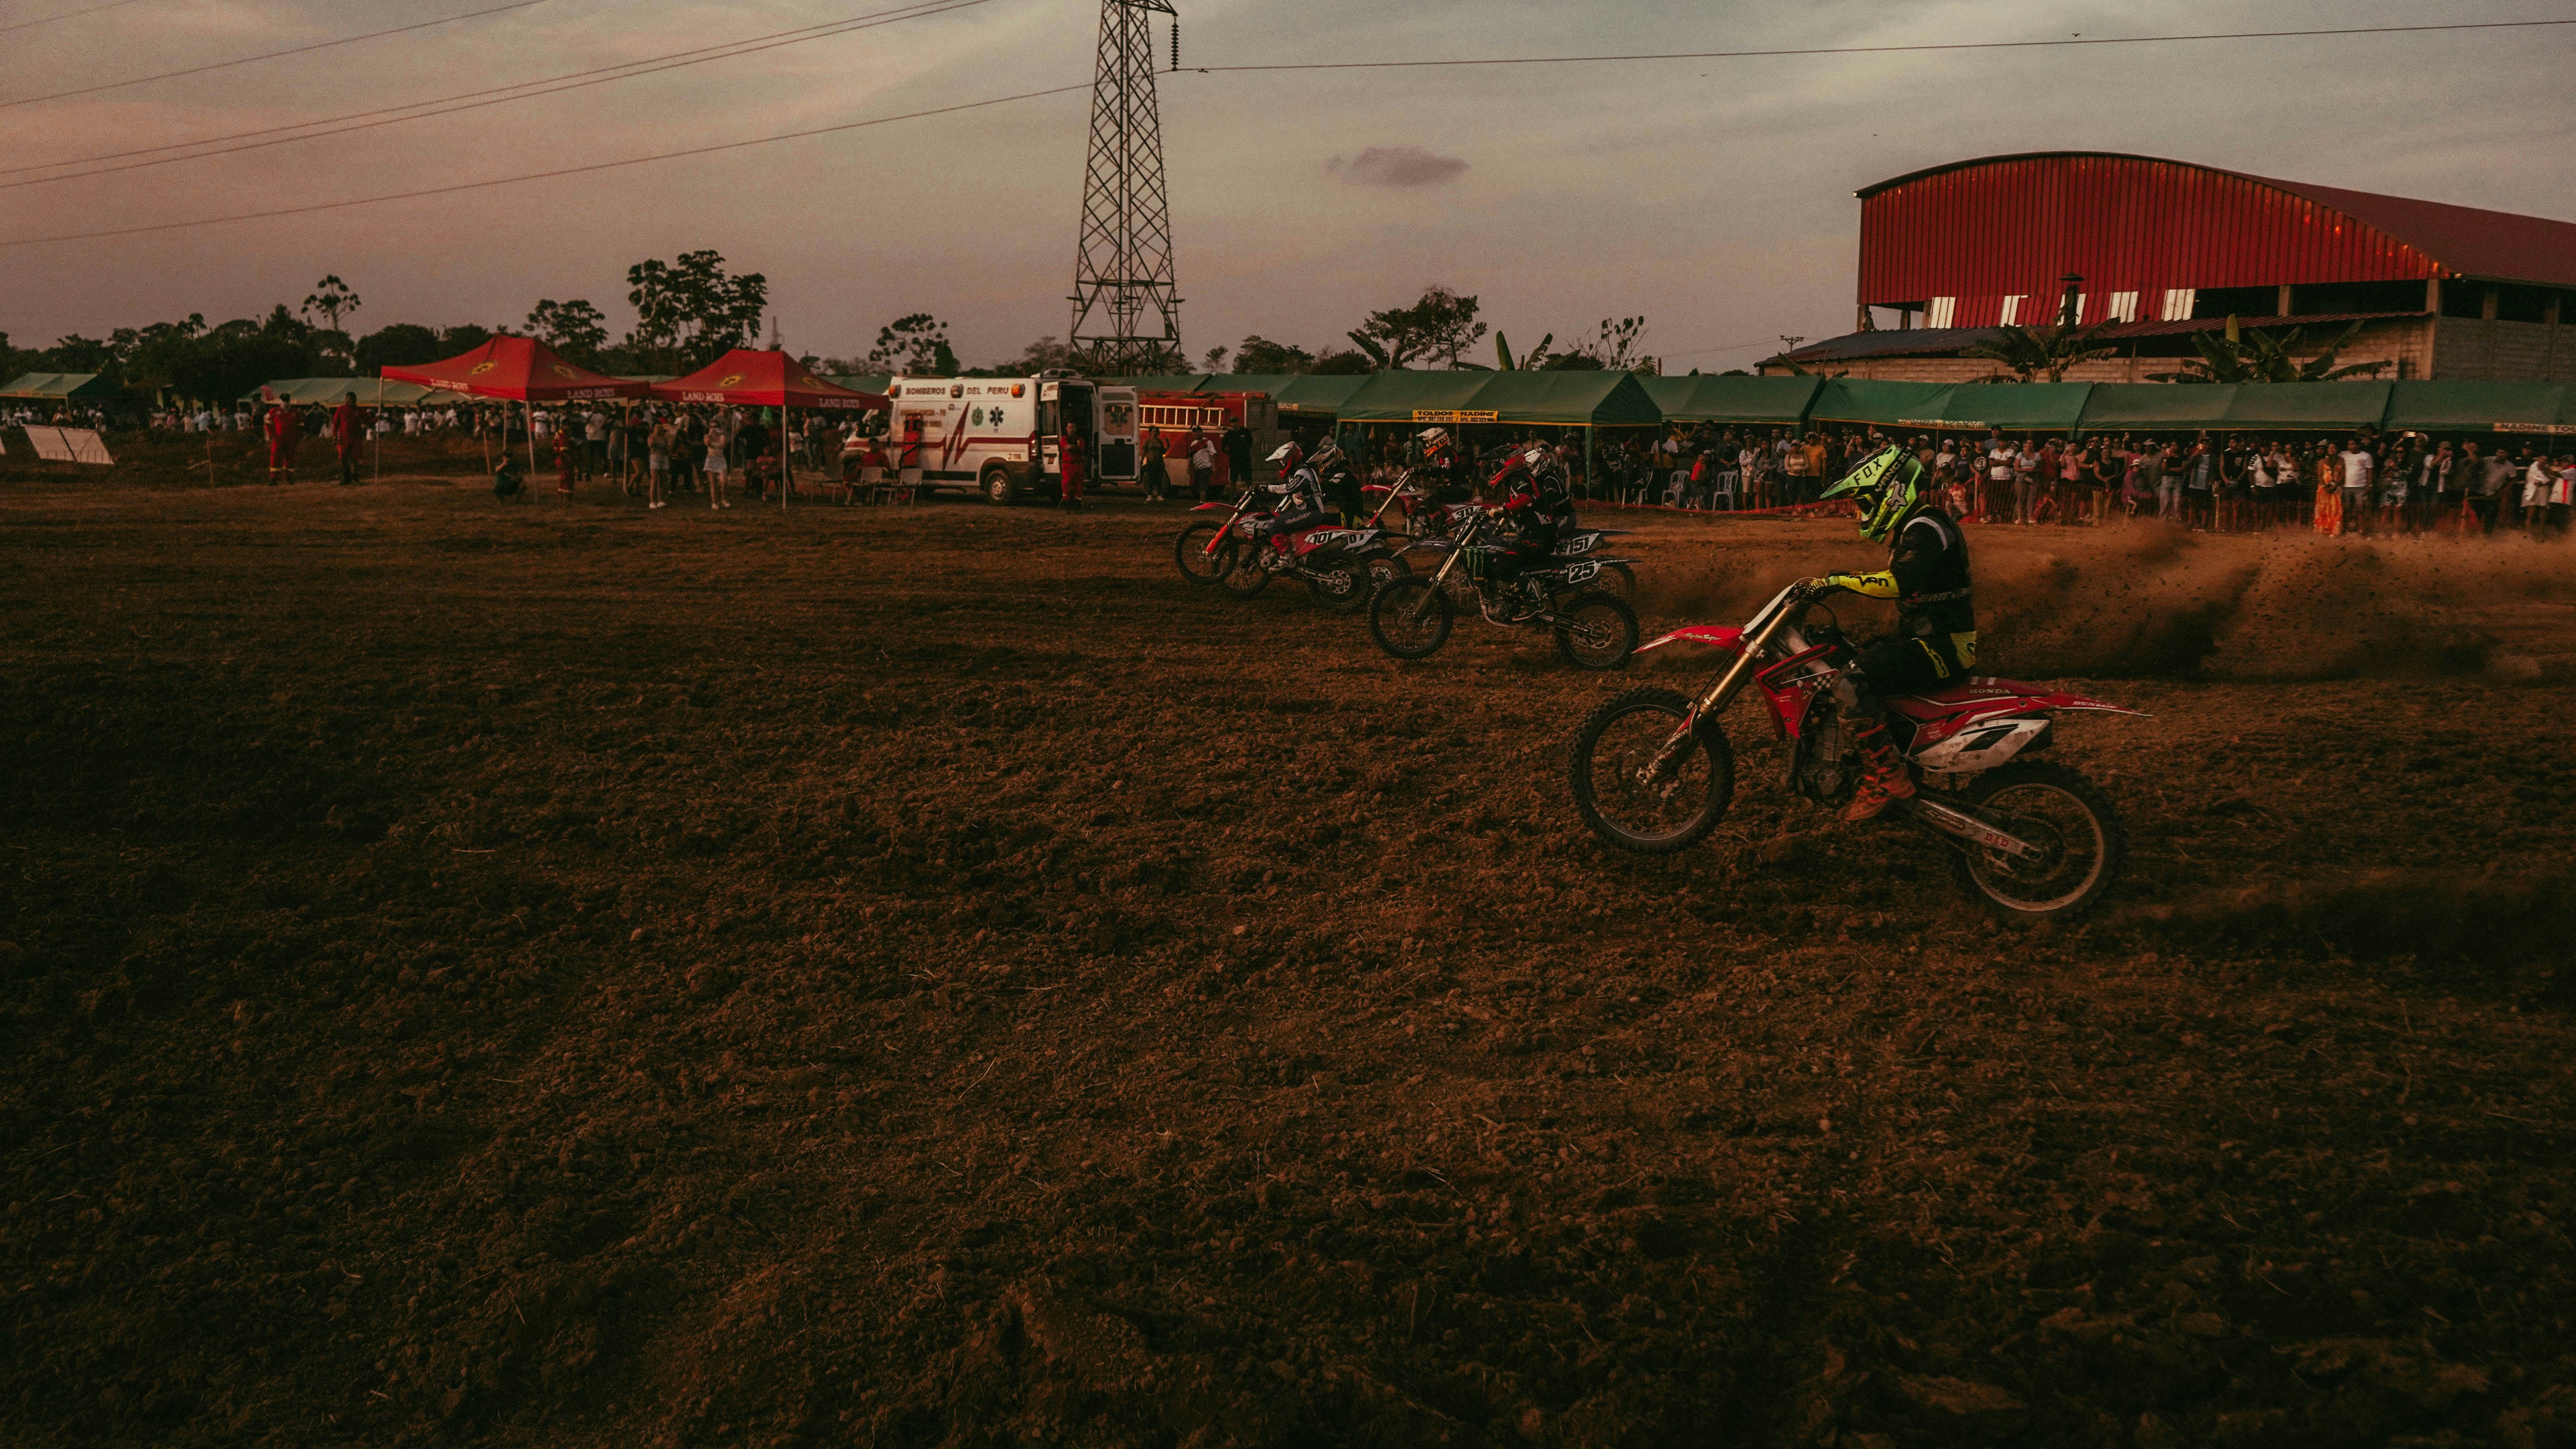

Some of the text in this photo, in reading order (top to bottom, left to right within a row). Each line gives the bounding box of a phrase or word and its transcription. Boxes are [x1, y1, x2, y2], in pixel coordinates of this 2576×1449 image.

[567, 389, 592, 398] LAND
[682, 391, 705, 401] LAND
[1853, 458, 1883, 485] FOX
[1313, 531, 1333, 545] 101
[1569, 536, 1589, 554] 151
[1570, 561, 1595, 582] 25
